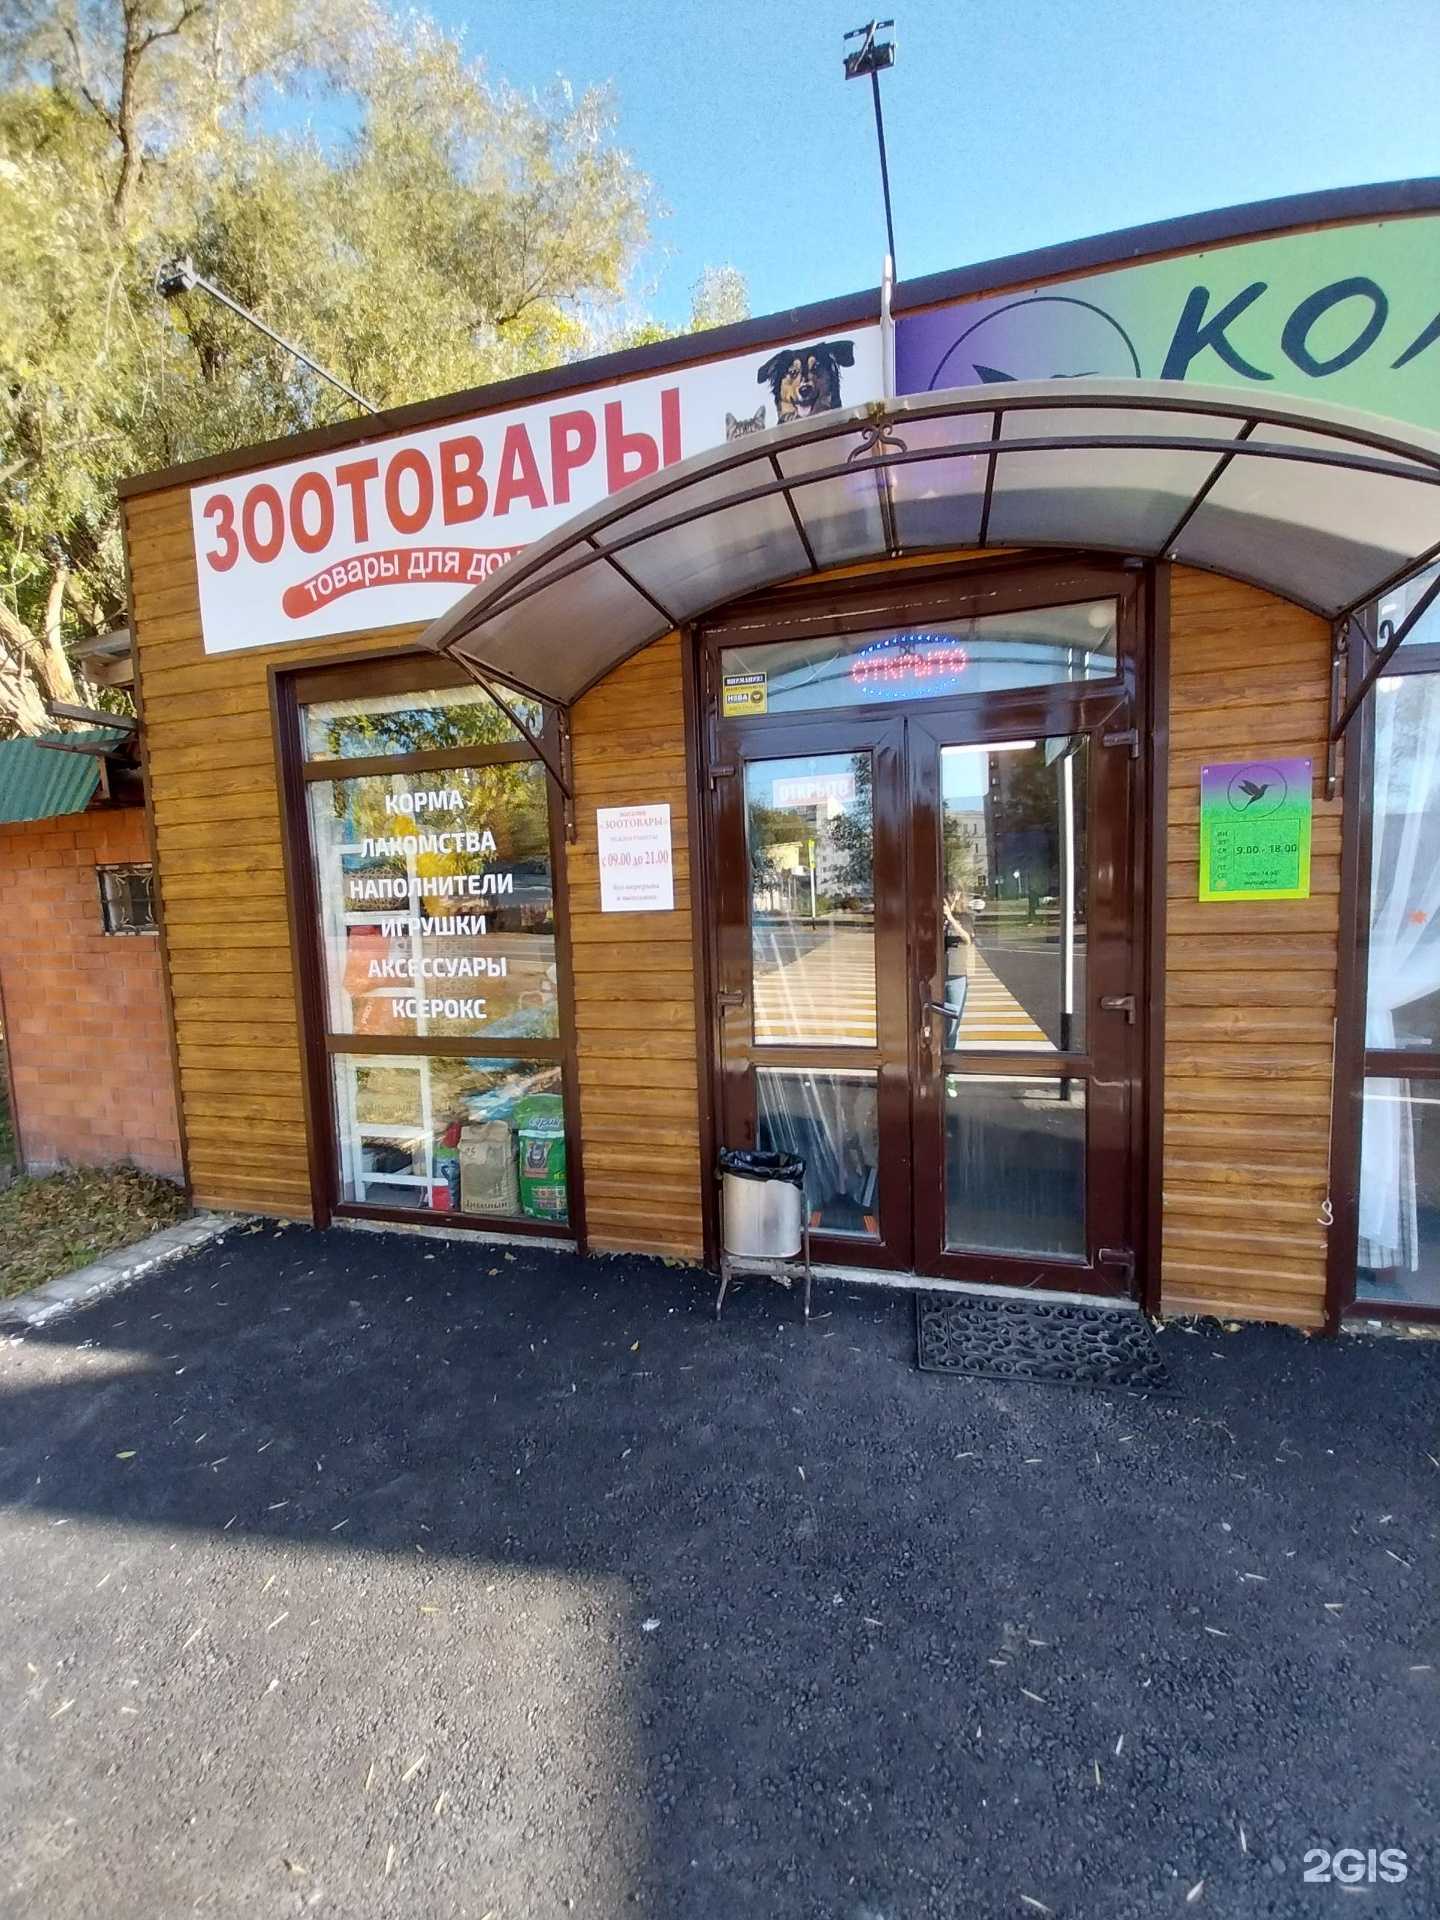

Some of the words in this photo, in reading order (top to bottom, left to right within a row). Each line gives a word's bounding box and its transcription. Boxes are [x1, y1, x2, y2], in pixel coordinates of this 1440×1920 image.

[203, 387, 682, 573] ЗООТОВАРЫ
[304, 551, 399, 602] товары
[407, 551, 460, 579] для
[385, 790, 465, 814] КОРМА
[361, 831, 497, 858] ЛАКОМСТВА
[644, 849, 669, 865] 21.00
[351, 873, 513, 899] НАПОЛНИТЕЛИ
[381, 915, 487, 938] ИГРУШКИ
[368, 957, 507, 978] АКСЕССУАРЫ
[392, 999, 488, 1019] КСЕРОКС
